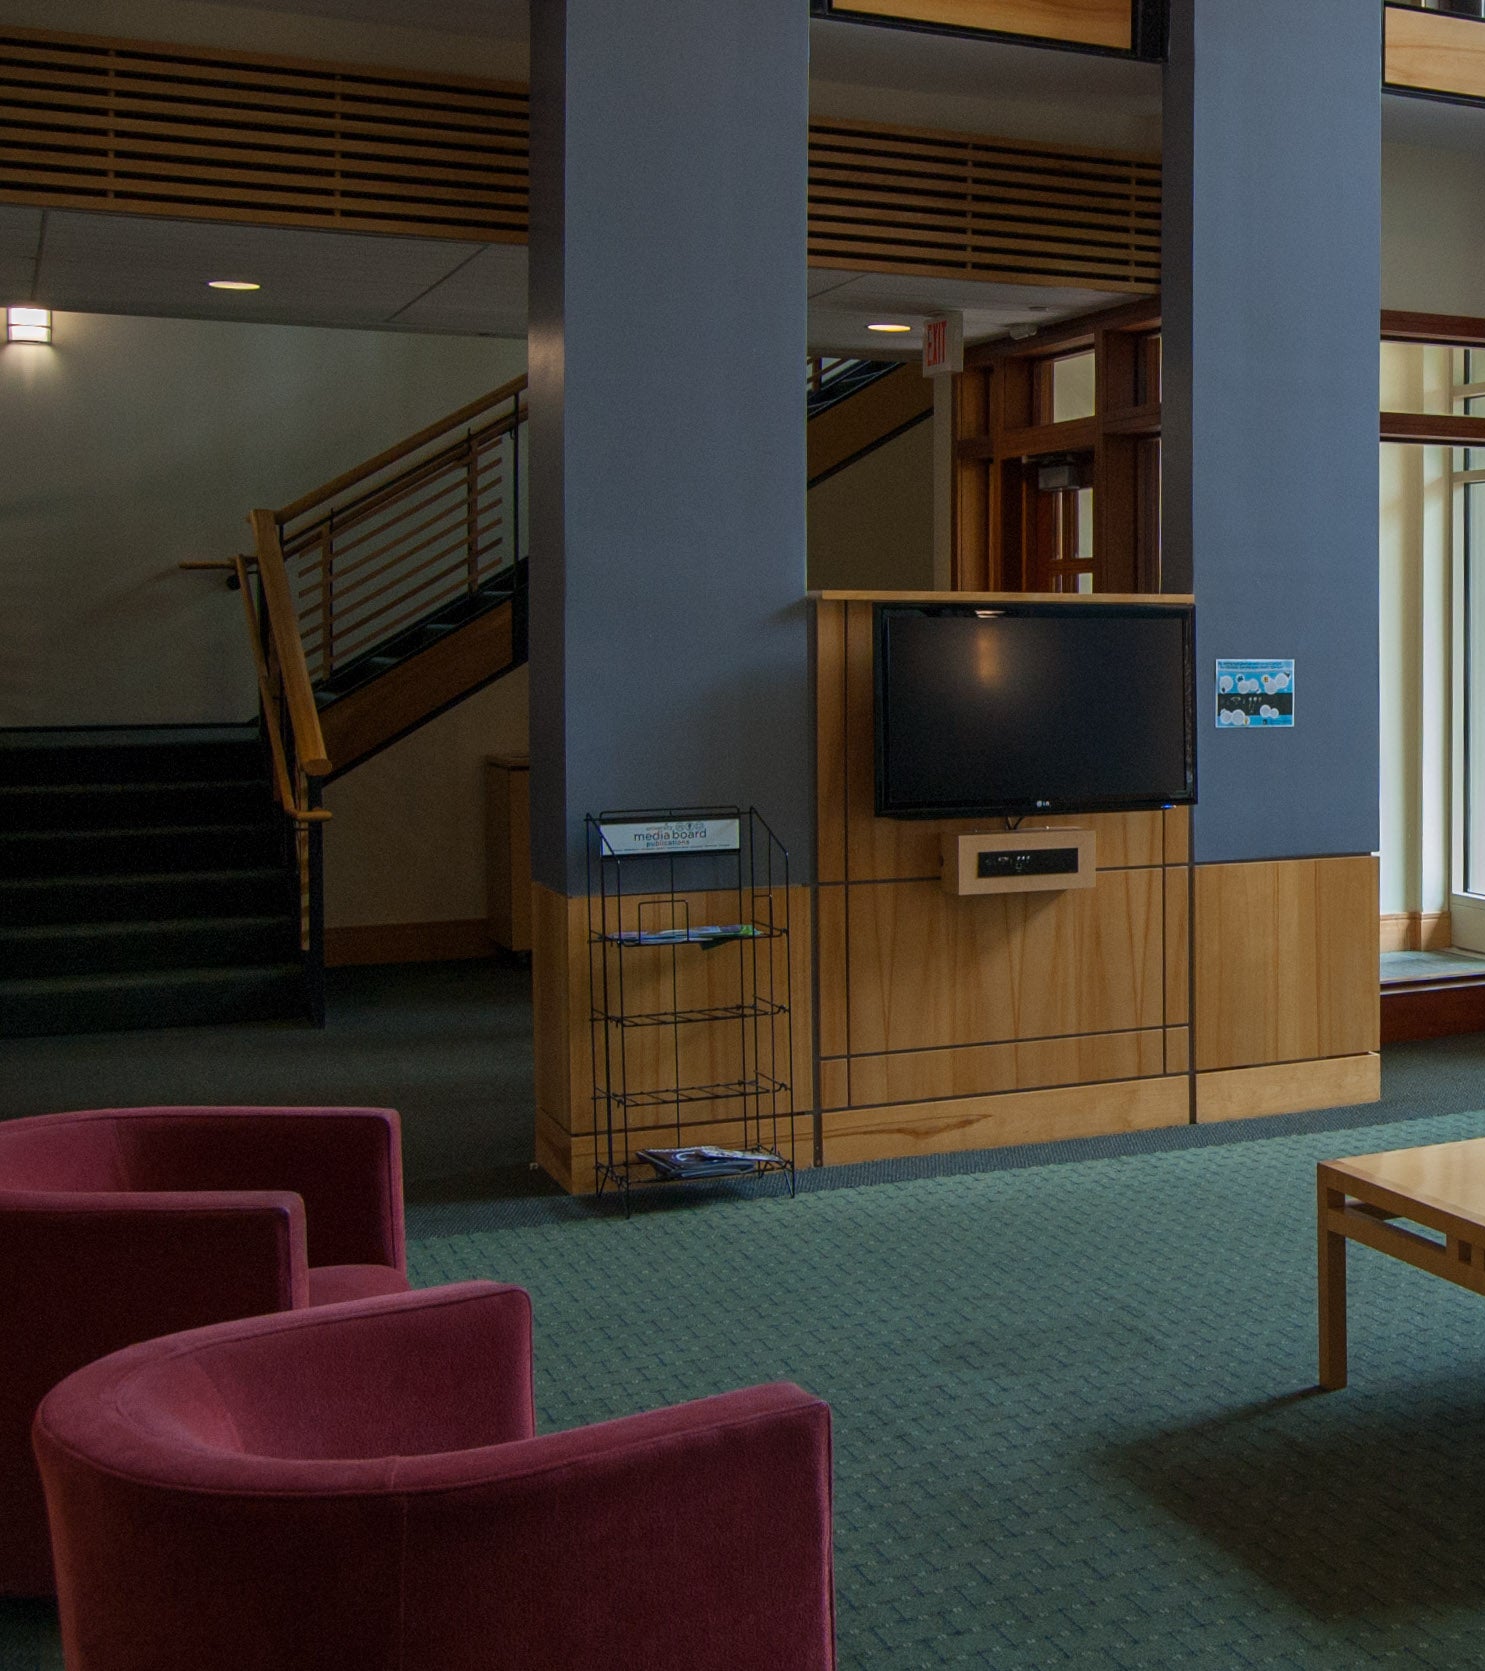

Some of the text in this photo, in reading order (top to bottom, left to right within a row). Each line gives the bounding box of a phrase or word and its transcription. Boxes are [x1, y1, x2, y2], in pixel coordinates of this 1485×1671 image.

[927, 320, 948, 367] EXIT
[634, 828, 707, 842] media board
